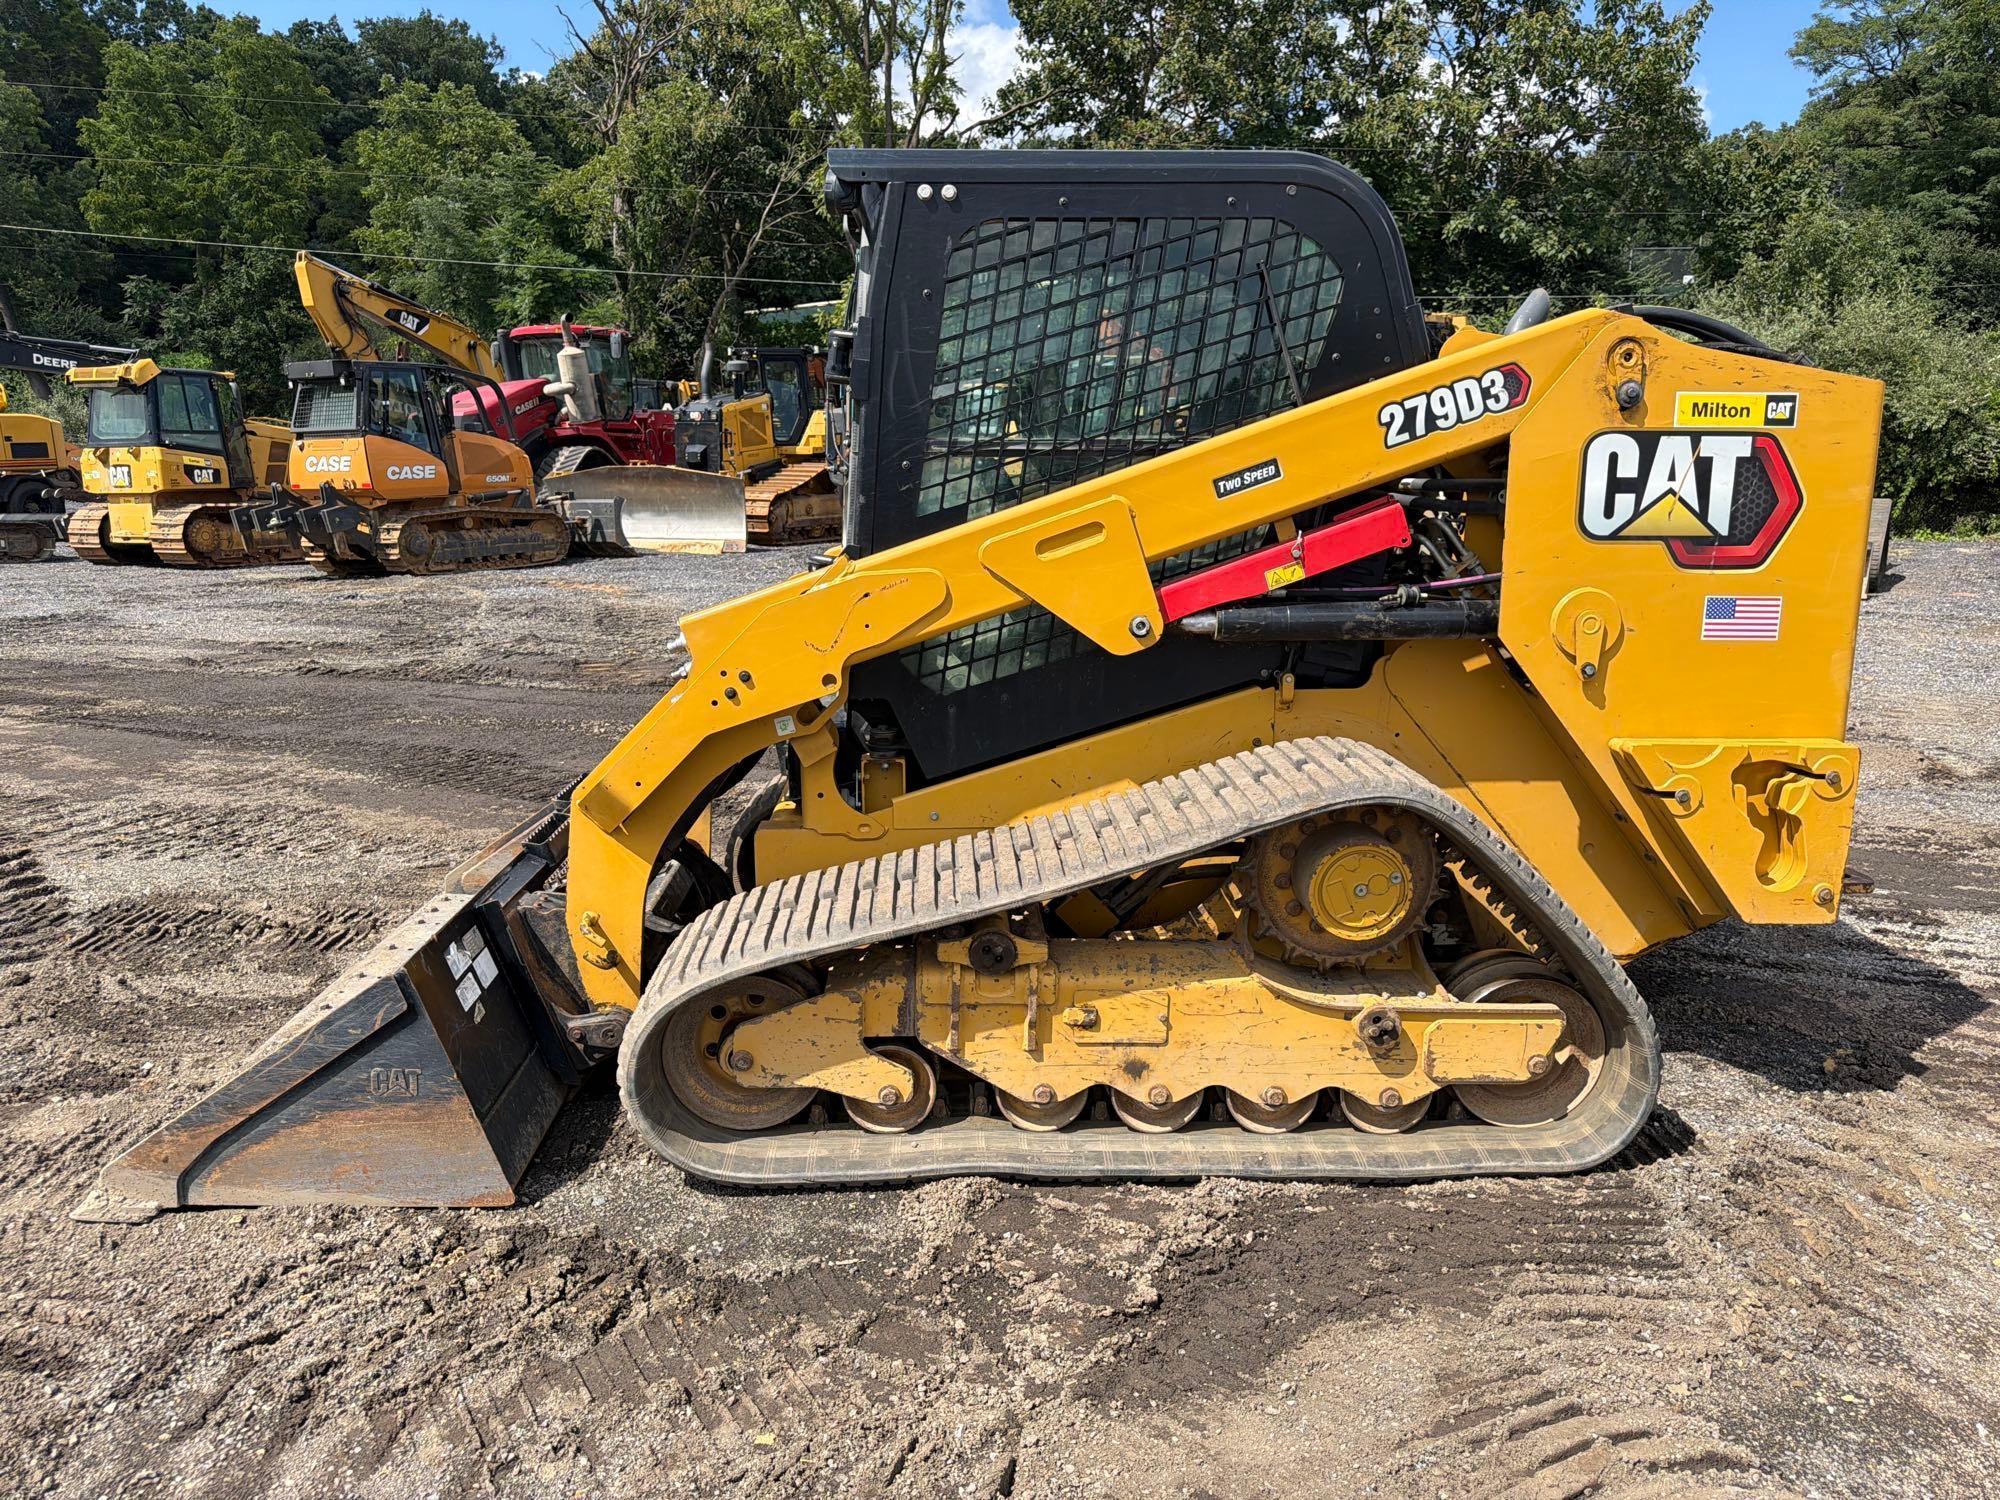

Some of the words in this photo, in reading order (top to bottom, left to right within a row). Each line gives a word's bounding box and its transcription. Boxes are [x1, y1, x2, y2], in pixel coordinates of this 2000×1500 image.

[399, 311, 421, 331] CAT
[33, 353, 78, 369] DEERE
[1380, 370, 1510, 447] 279D3
[1691, 402, 1751, 418] Milton
[1767, 402, 1793, 419] CAT
[305, 456, 352, 472] CASE
[109, 465, 130, 487] CAT
[194, 468, 214, 484] CAT
[386, 465, 436, 480] CASE
[485, 475, 510, 483] 650M
[1582, 433, 1753, 537] CAT
[370, 1067, 422, 1097] CAT
